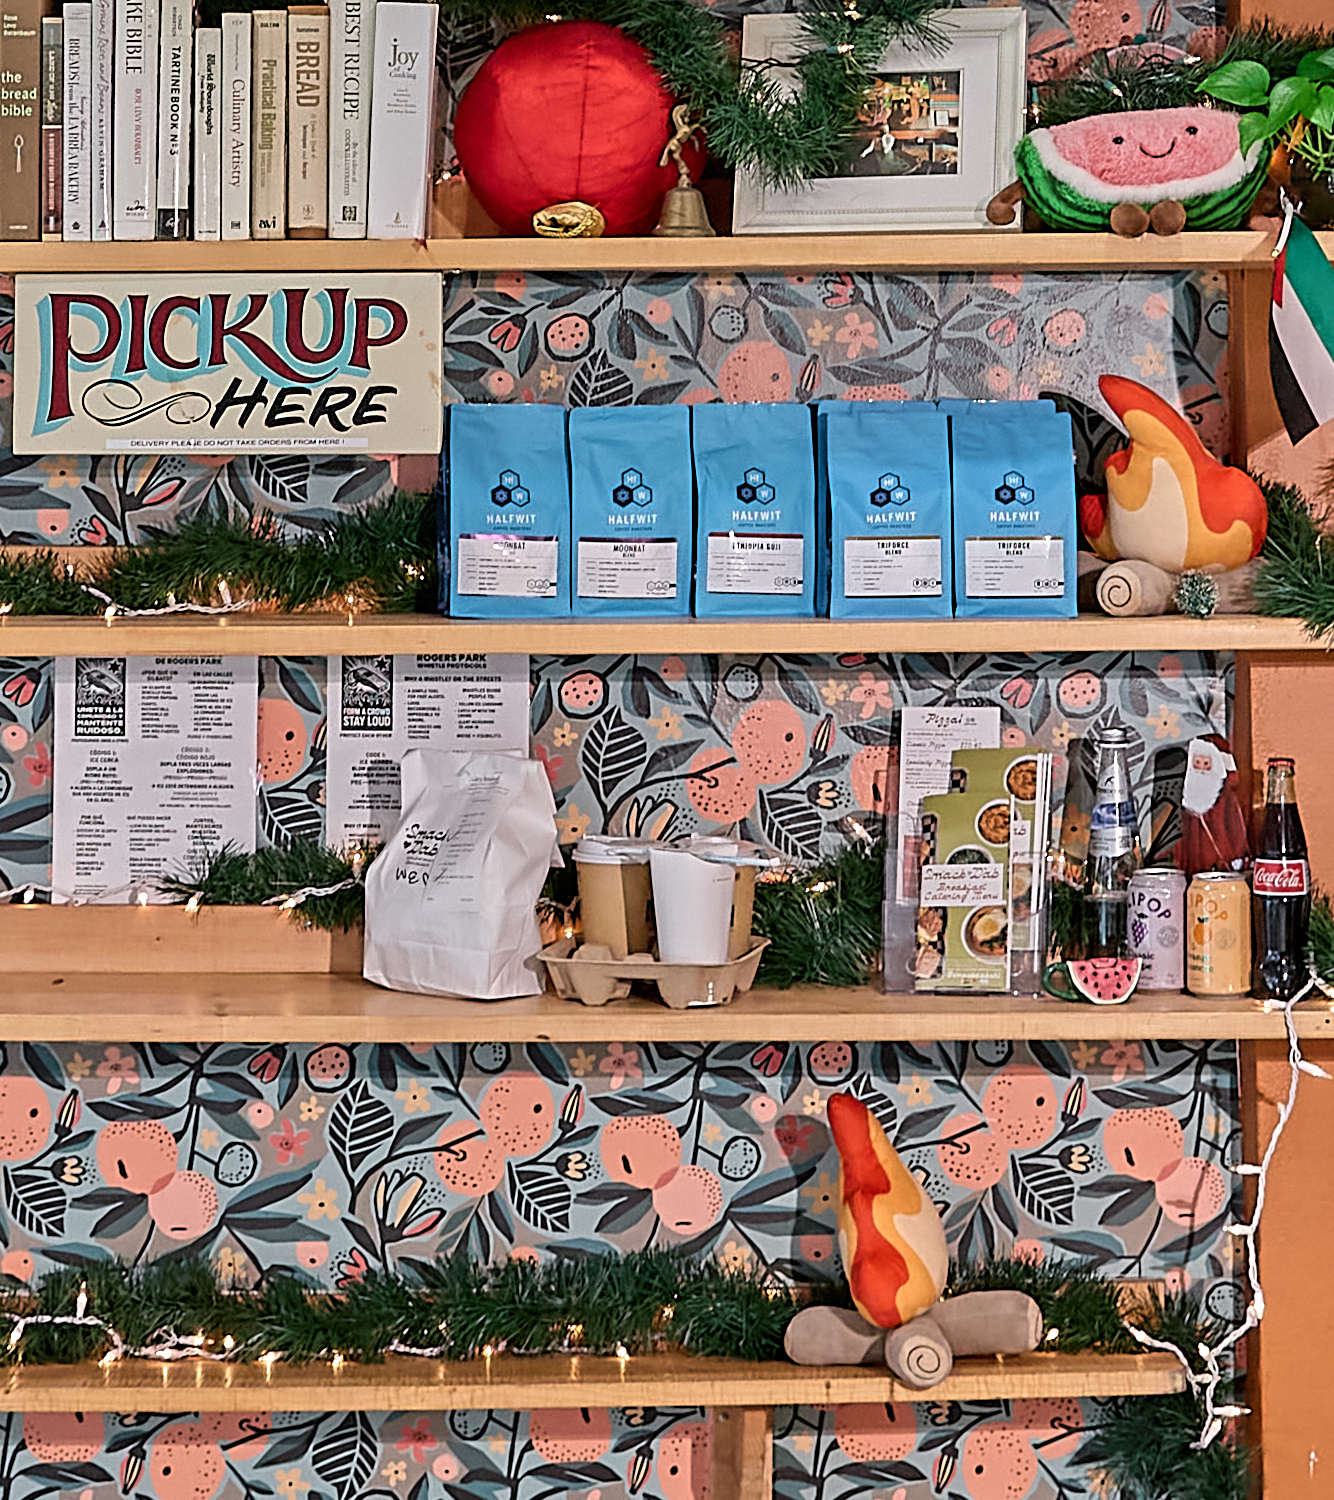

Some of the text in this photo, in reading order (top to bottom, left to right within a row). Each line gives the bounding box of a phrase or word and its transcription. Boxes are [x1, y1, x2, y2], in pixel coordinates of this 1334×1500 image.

[345, 2, 360, 47] BEST
[125, 29, 142, 74] BIBLE
[68, 38, 80, 80] BREADS
[1, 71, 22, 83] the
[296, 41, 320, 107] BREAD
[170, 46, 181, 129] TARTINE BOOK
[343, 53, 360, 120] RECIPE
[1, 88, 37, 100] bread
[1, 104, 33, 117] bible
[259, 59, 277, 150] Practical Baking
[68, 117, 79, 131] LA
[229, 79, 246, 187] Culinary Artistry
[68, 132, 79, 160] BREA
[67, 162, 79, 204] BAKERY
[44, 288, 408, 424] PICKUP
[209, 377, 398, 432] HERE
[486, 514, 537, 525] HALFWIT
[608, 514, 658, 525] HALFWIT
[732, 510, 781, 521] HALFWIT
[866, 511, 917, 524] HALFWIT
[990, 511, 1040, 522] HALFWIT
[613, 544, 646, 553] MOONBAT
[877, 541, 910, 549] TRIFORCE
[997, 542, 1030, 550] TRIFORCE
[344, 717, 391, 727] STAY LOUD
